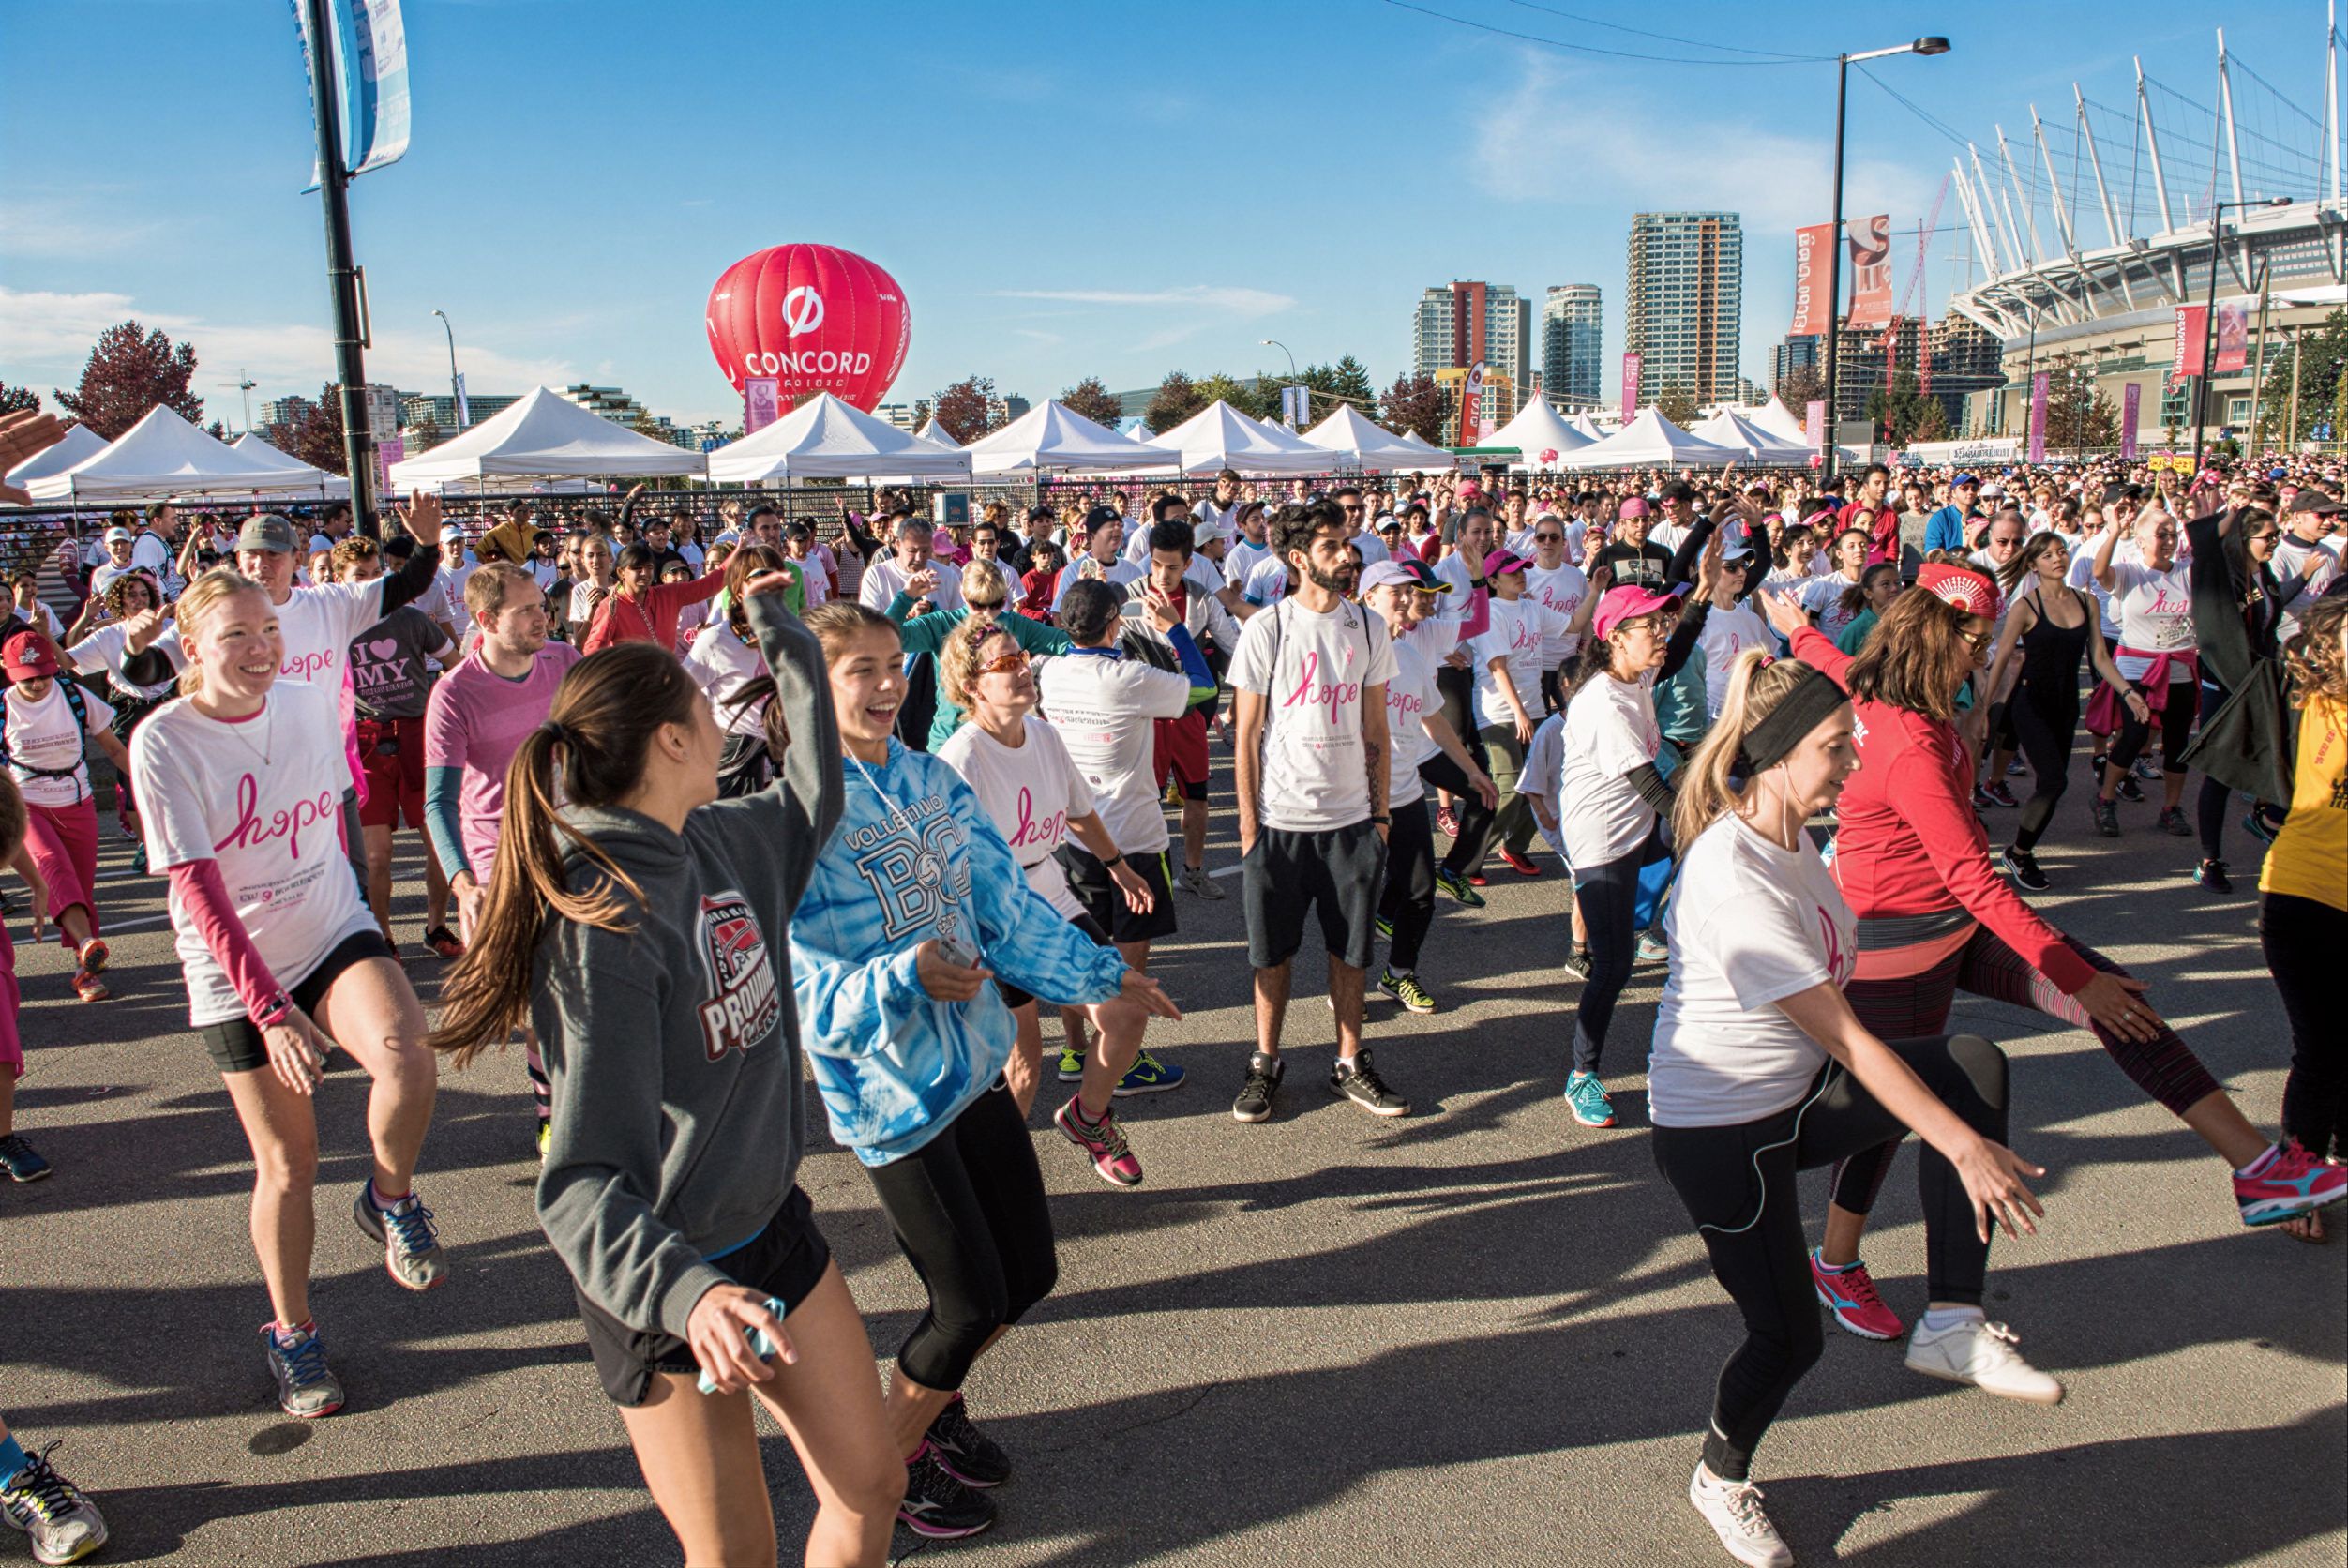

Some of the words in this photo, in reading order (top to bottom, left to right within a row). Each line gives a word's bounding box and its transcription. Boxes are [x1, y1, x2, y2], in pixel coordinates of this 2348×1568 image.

[745, 350, 871, 376] CONCORD
[280, 649, 334, 683] ope
[354, 642, 372, 666] I
[354, 658, 410, 689] MY
[1282, 651, 1358, 725] hope
[214, 772, 335, 860] hope
[1008, 786, 1066, 847] hop
